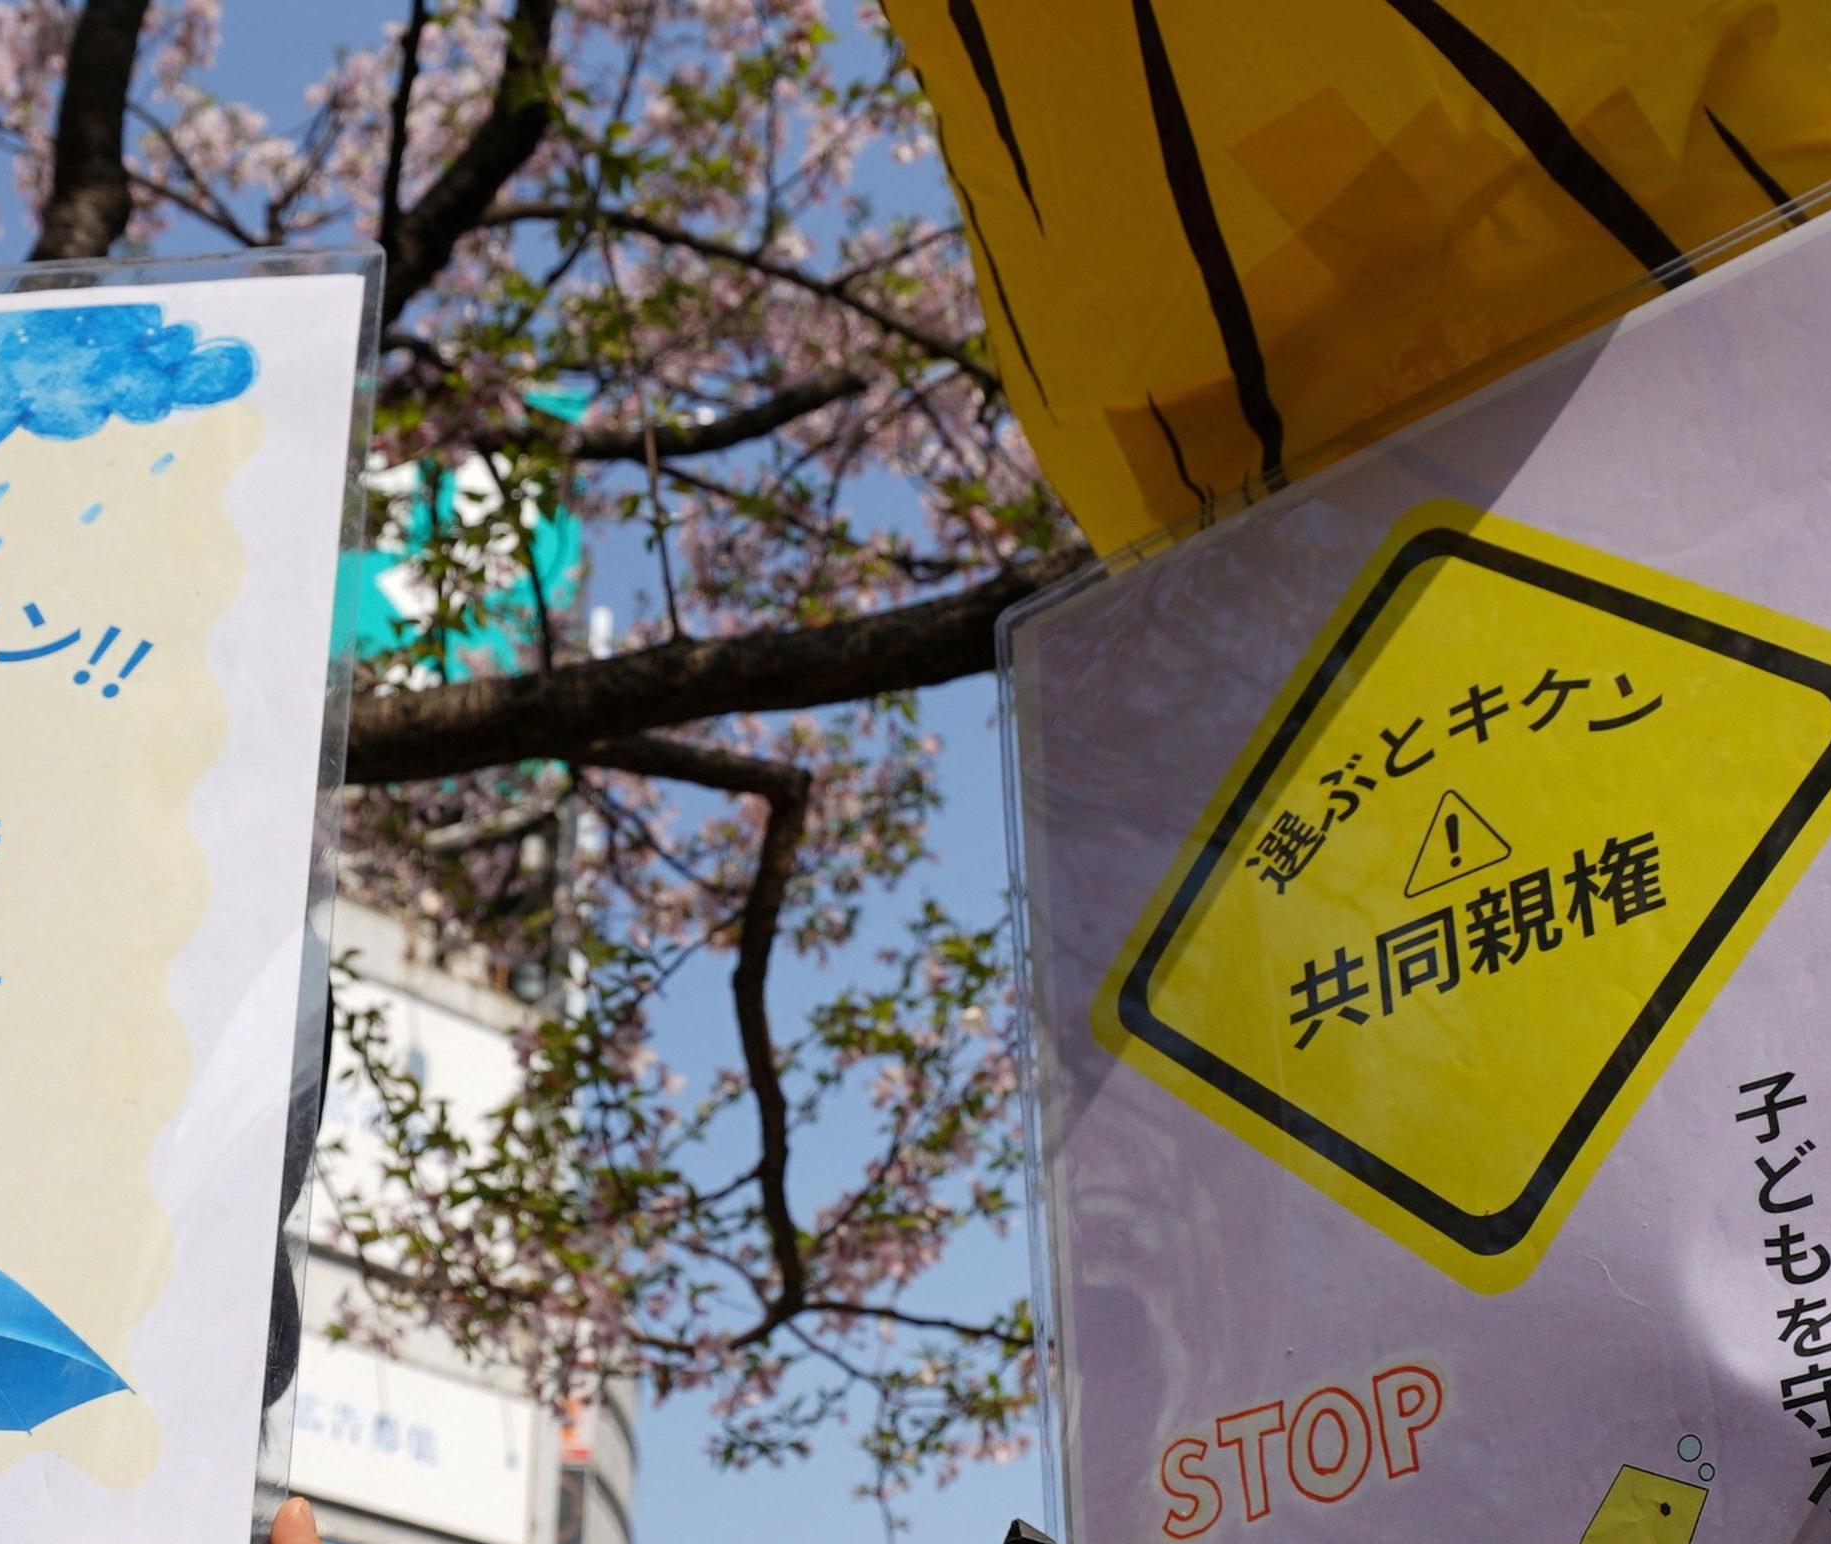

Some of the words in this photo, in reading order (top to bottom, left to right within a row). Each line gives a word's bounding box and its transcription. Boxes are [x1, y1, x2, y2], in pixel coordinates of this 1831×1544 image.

[1245, 668, 1663, 895] 選ぶとキケン
[1289, 831, 1667, 1050] 共同親権
[1160, 1364, 1445, 1541] STOP
